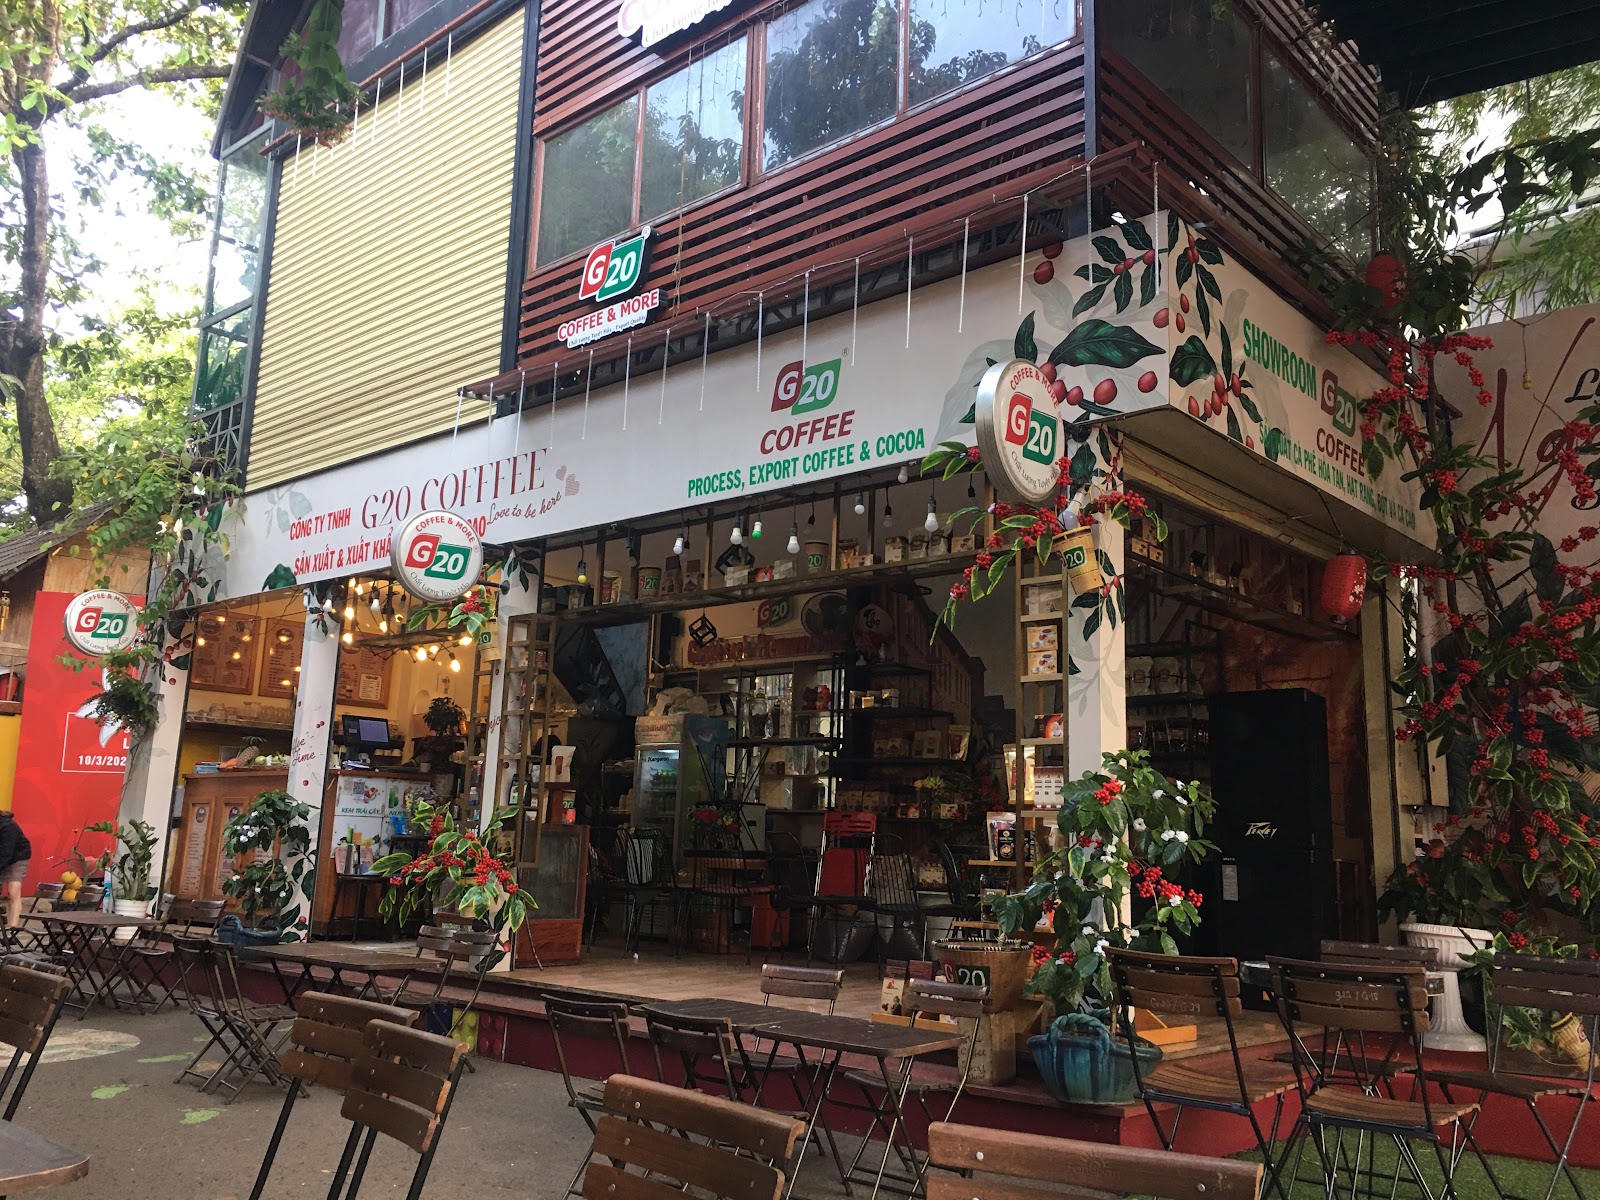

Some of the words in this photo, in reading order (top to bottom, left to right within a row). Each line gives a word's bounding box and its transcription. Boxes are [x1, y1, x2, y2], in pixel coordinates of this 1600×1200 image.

[587, 250, 637, 289] G20
[558, 311, 603, 340] COFFEE
[606, 307, 616, 322] &
[620, 291, 659, 318] MORE
[1243, 318, 1317, 401] SHOWROOM
[777, 369, 835, 406] G20
[1009, 367, 1033, 391] COFFEE
[1034, 370, 1040, 381] &
[1041, 376, 1059, 409] MORE
[1323, 378, 1353, 428] G20
[760, 409, 855, 455] COFFEE
[1010, 404, 1053, 457] G20
[687, 469, 745, 498] PROCESS,
[749, 456, 799, 486] EXPORT
[802, 443, 855, 475] COFFEE
[859, 440, 871, 462] &
[875, 427, 925, 458] COCOA
[1316, 427, 1365, 477] COFFEE
[290, 516, 312, 541] CÔNG
[314, 514, 326, 535] TY
[327, 507, 351, 531] TNHH
[361, 485, 411, 529] G20
[486, 502, 512, 525] Love
[511, 503, 522, 518] to
[523, 502, 538, 519] be
[538, 490, 562, 516] here
[415, 515, 446, 533] COFFEE
[447, 517, 454, 525] &
[455, 520, 476, 544] MORE
[293, 550, 311, 577] SẢN
[311, 543, 336, 573] XUẤT
[336, 548, 344, 568] &
[345, 535, 370, 566] XUẤT
[412, 540, 465, 575] G20
[81, 592, 106, 607] COFFEE
[113, 595, 132, 611] MORE
[80, 611, 124, 635] G20
[78, 755, 127, 767] 10/3/202
